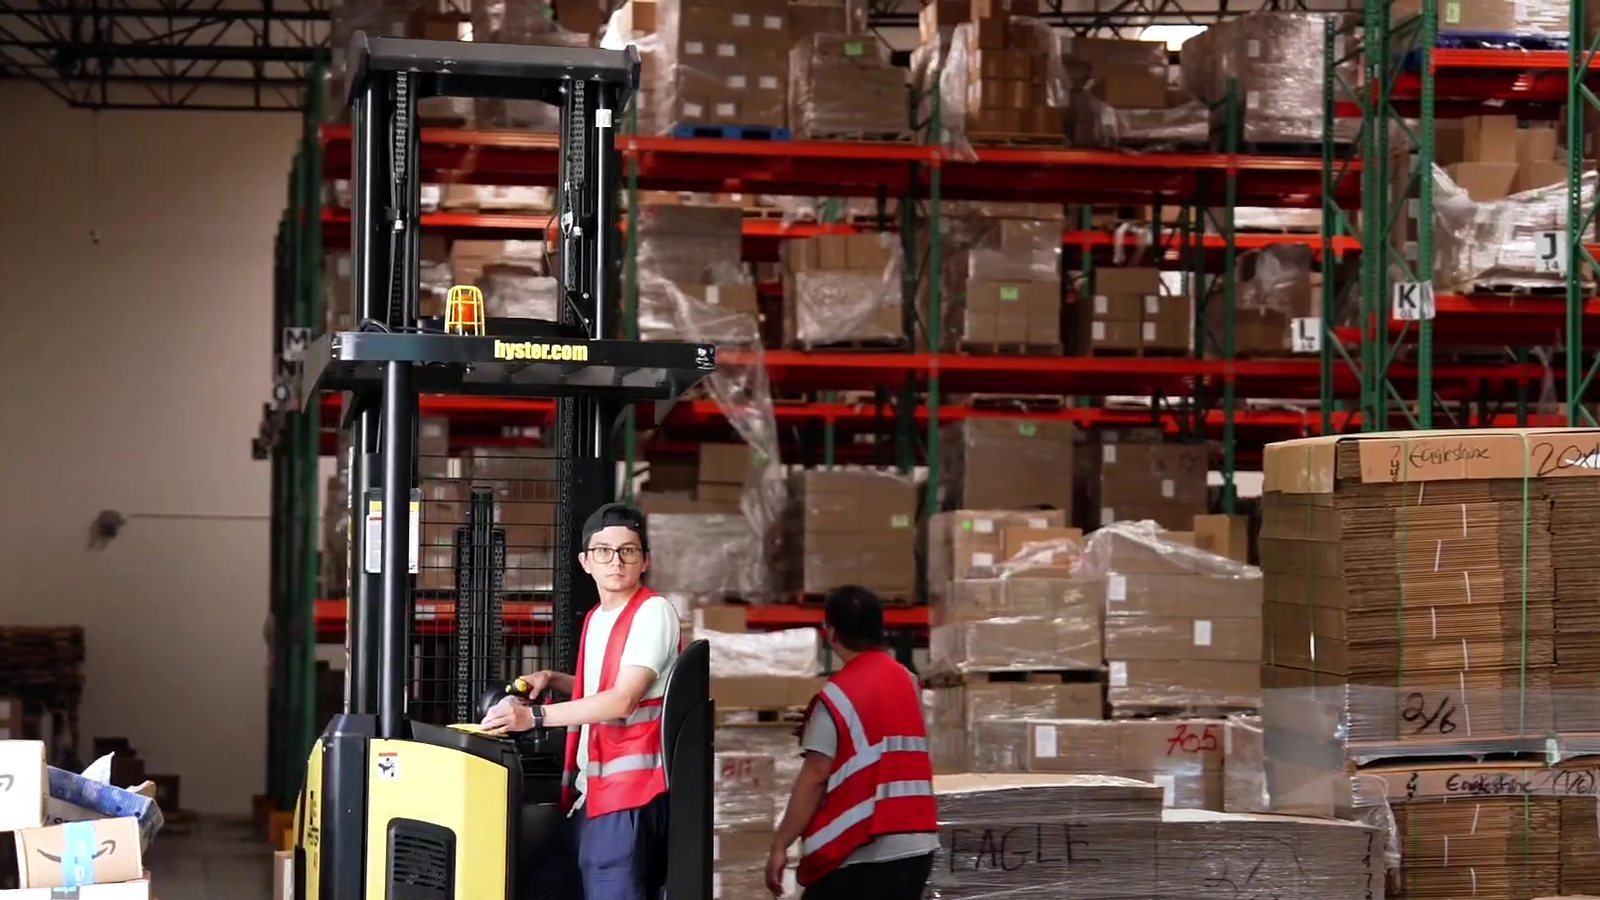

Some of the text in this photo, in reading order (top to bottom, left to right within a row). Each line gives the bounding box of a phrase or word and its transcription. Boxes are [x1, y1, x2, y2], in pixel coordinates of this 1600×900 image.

[1541, 232, 1557, 260] J
[1399, 284, 1417, 308] K
[1300, 319, 1315, 341] L
[494, 339, 588, 361] hyster.com
[1167, 724, 1217, 757] 705
[951, 822, 1101, 873] EAGLE
